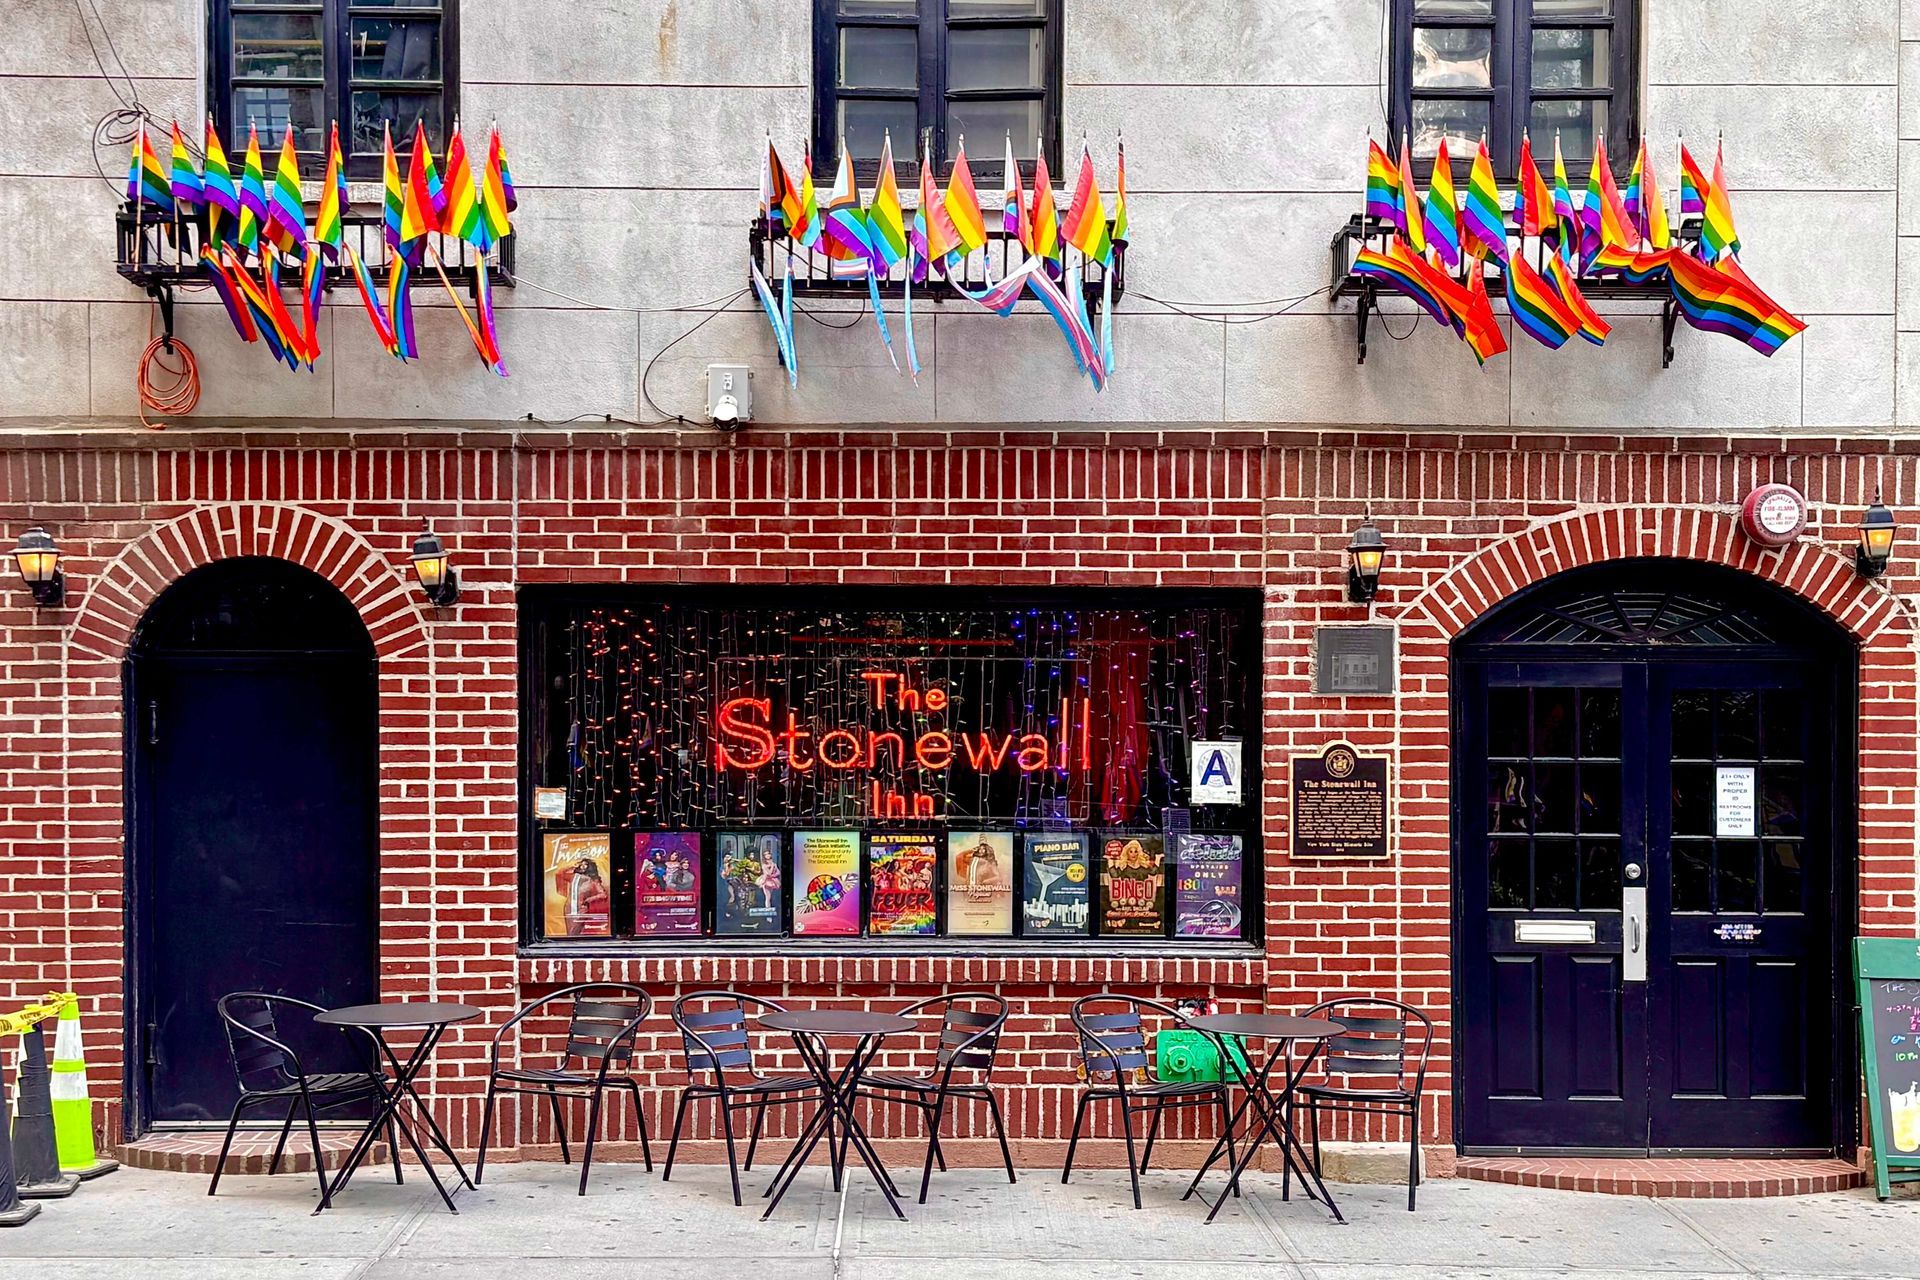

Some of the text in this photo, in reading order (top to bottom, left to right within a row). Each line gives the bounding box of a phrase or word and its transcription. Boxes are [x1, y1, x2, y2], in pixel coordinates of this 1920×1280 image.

[861, 672, 947, 710] The
[716, 697, 1091, 771] Stonewall
[1200, 750, 1233, 785] A
[1303, 780, 1377, 788] The Stonewall Inn
[873, 780, 934, 818] Inn
[871, 835, 935, 843] SATURDAY
[1034, 842, 1079, 852] PIANO BAR
[1111, 878, 1154, 900] BINGO
[1178, 879, 1210, 891] 1800
[873, 892, 931, 909] FEVER
